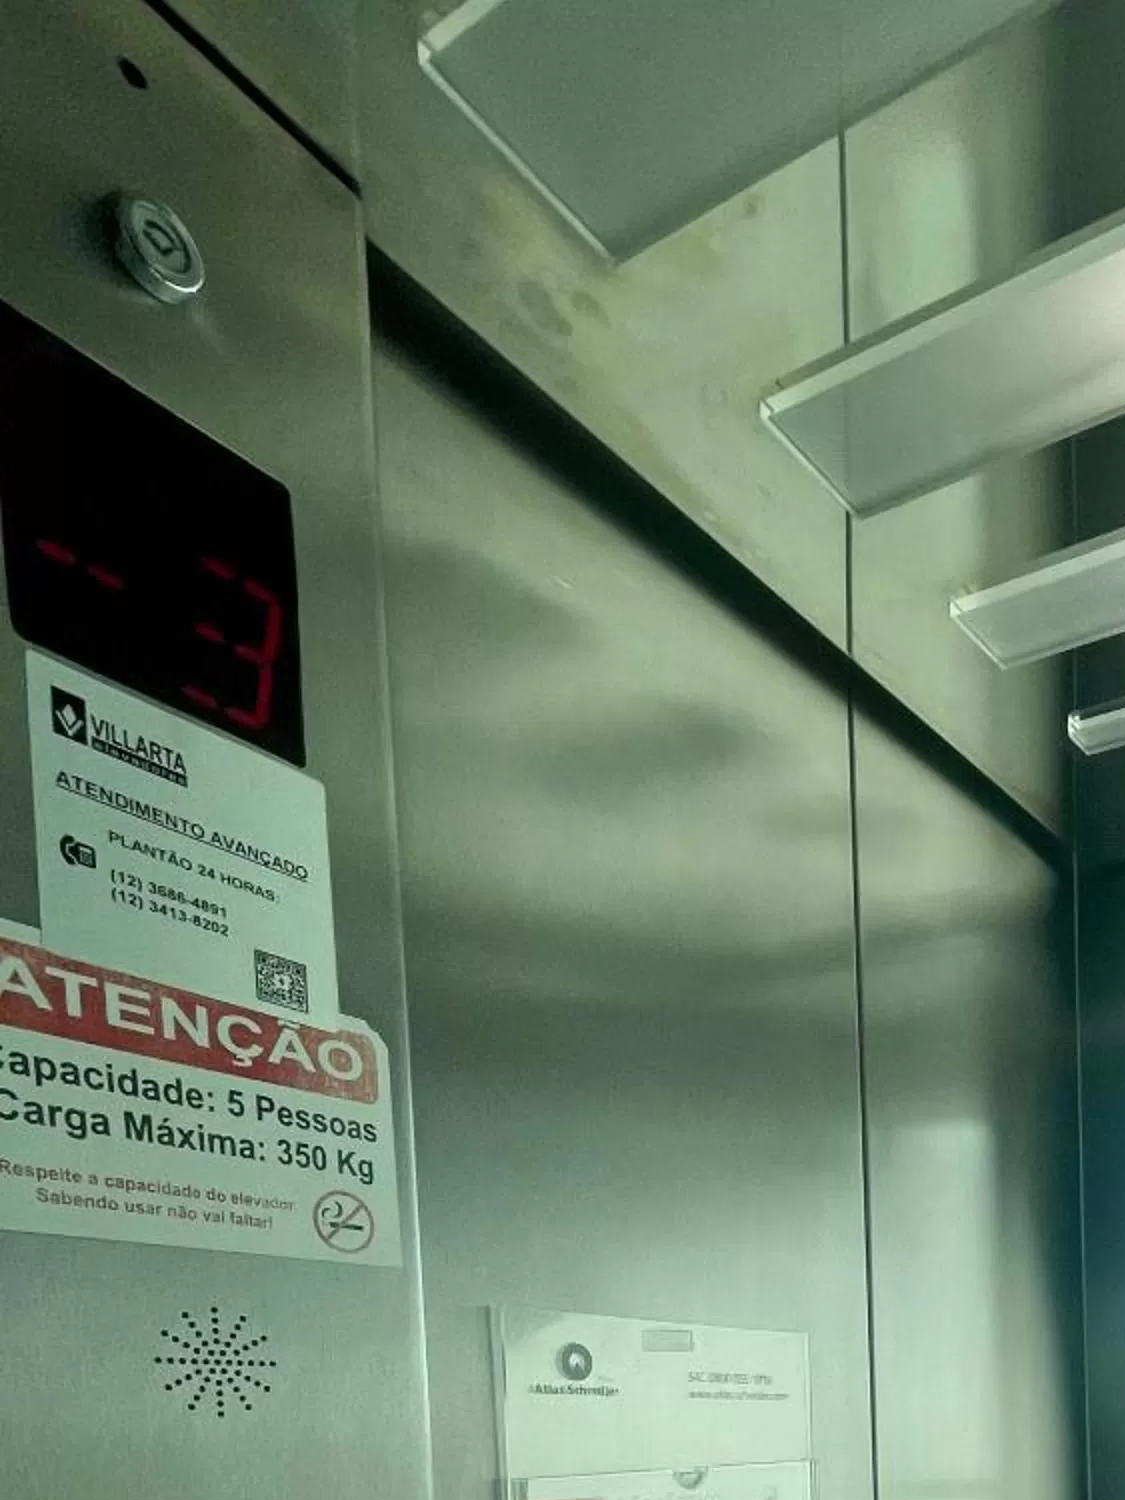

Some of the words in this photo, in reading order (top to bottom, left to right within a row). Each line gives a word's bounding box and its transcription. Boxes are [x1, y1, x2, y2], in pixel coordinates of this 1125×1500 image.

[90, 713, 187, 775] VILLARTA
[56, 771, 205, 840] ATENDIMENTO
[211, 831, 309, 881] AVANÇADO
[108, 829, 193, 872] PLANTÃO
[197, 863, 216, 880] 24
[110, 868, 143, 892] (12)
[111, 887, 144, 911] (12)
[0, 955, 364, 1082] ATENÇÃO
[0, 1046, 215, 1113] apacidade:
[228, 1089, 246, 1118] 5
[255, 1094, 378, 1143] Pessoas
[0, 1088, 111, 1140] Carga
[124, 1111, 266, 1162] Máxima:
[277, 1138, 327, 1173] 350
[337, 1148, 375, 1186] Kg
[0, 1159, 83, 1184] Respeite
[88, 1174, 98, 1186] a
[104, 1175, 201, 1200] capacidade
[206, 1188, 227, 1203] do
[36, 1186, 119, 1212] Sabendo
[124, 1201, 162, 1218] usar
[167, 1203, 198, 1222] não
[202, 1211, 225, 1225] vai
